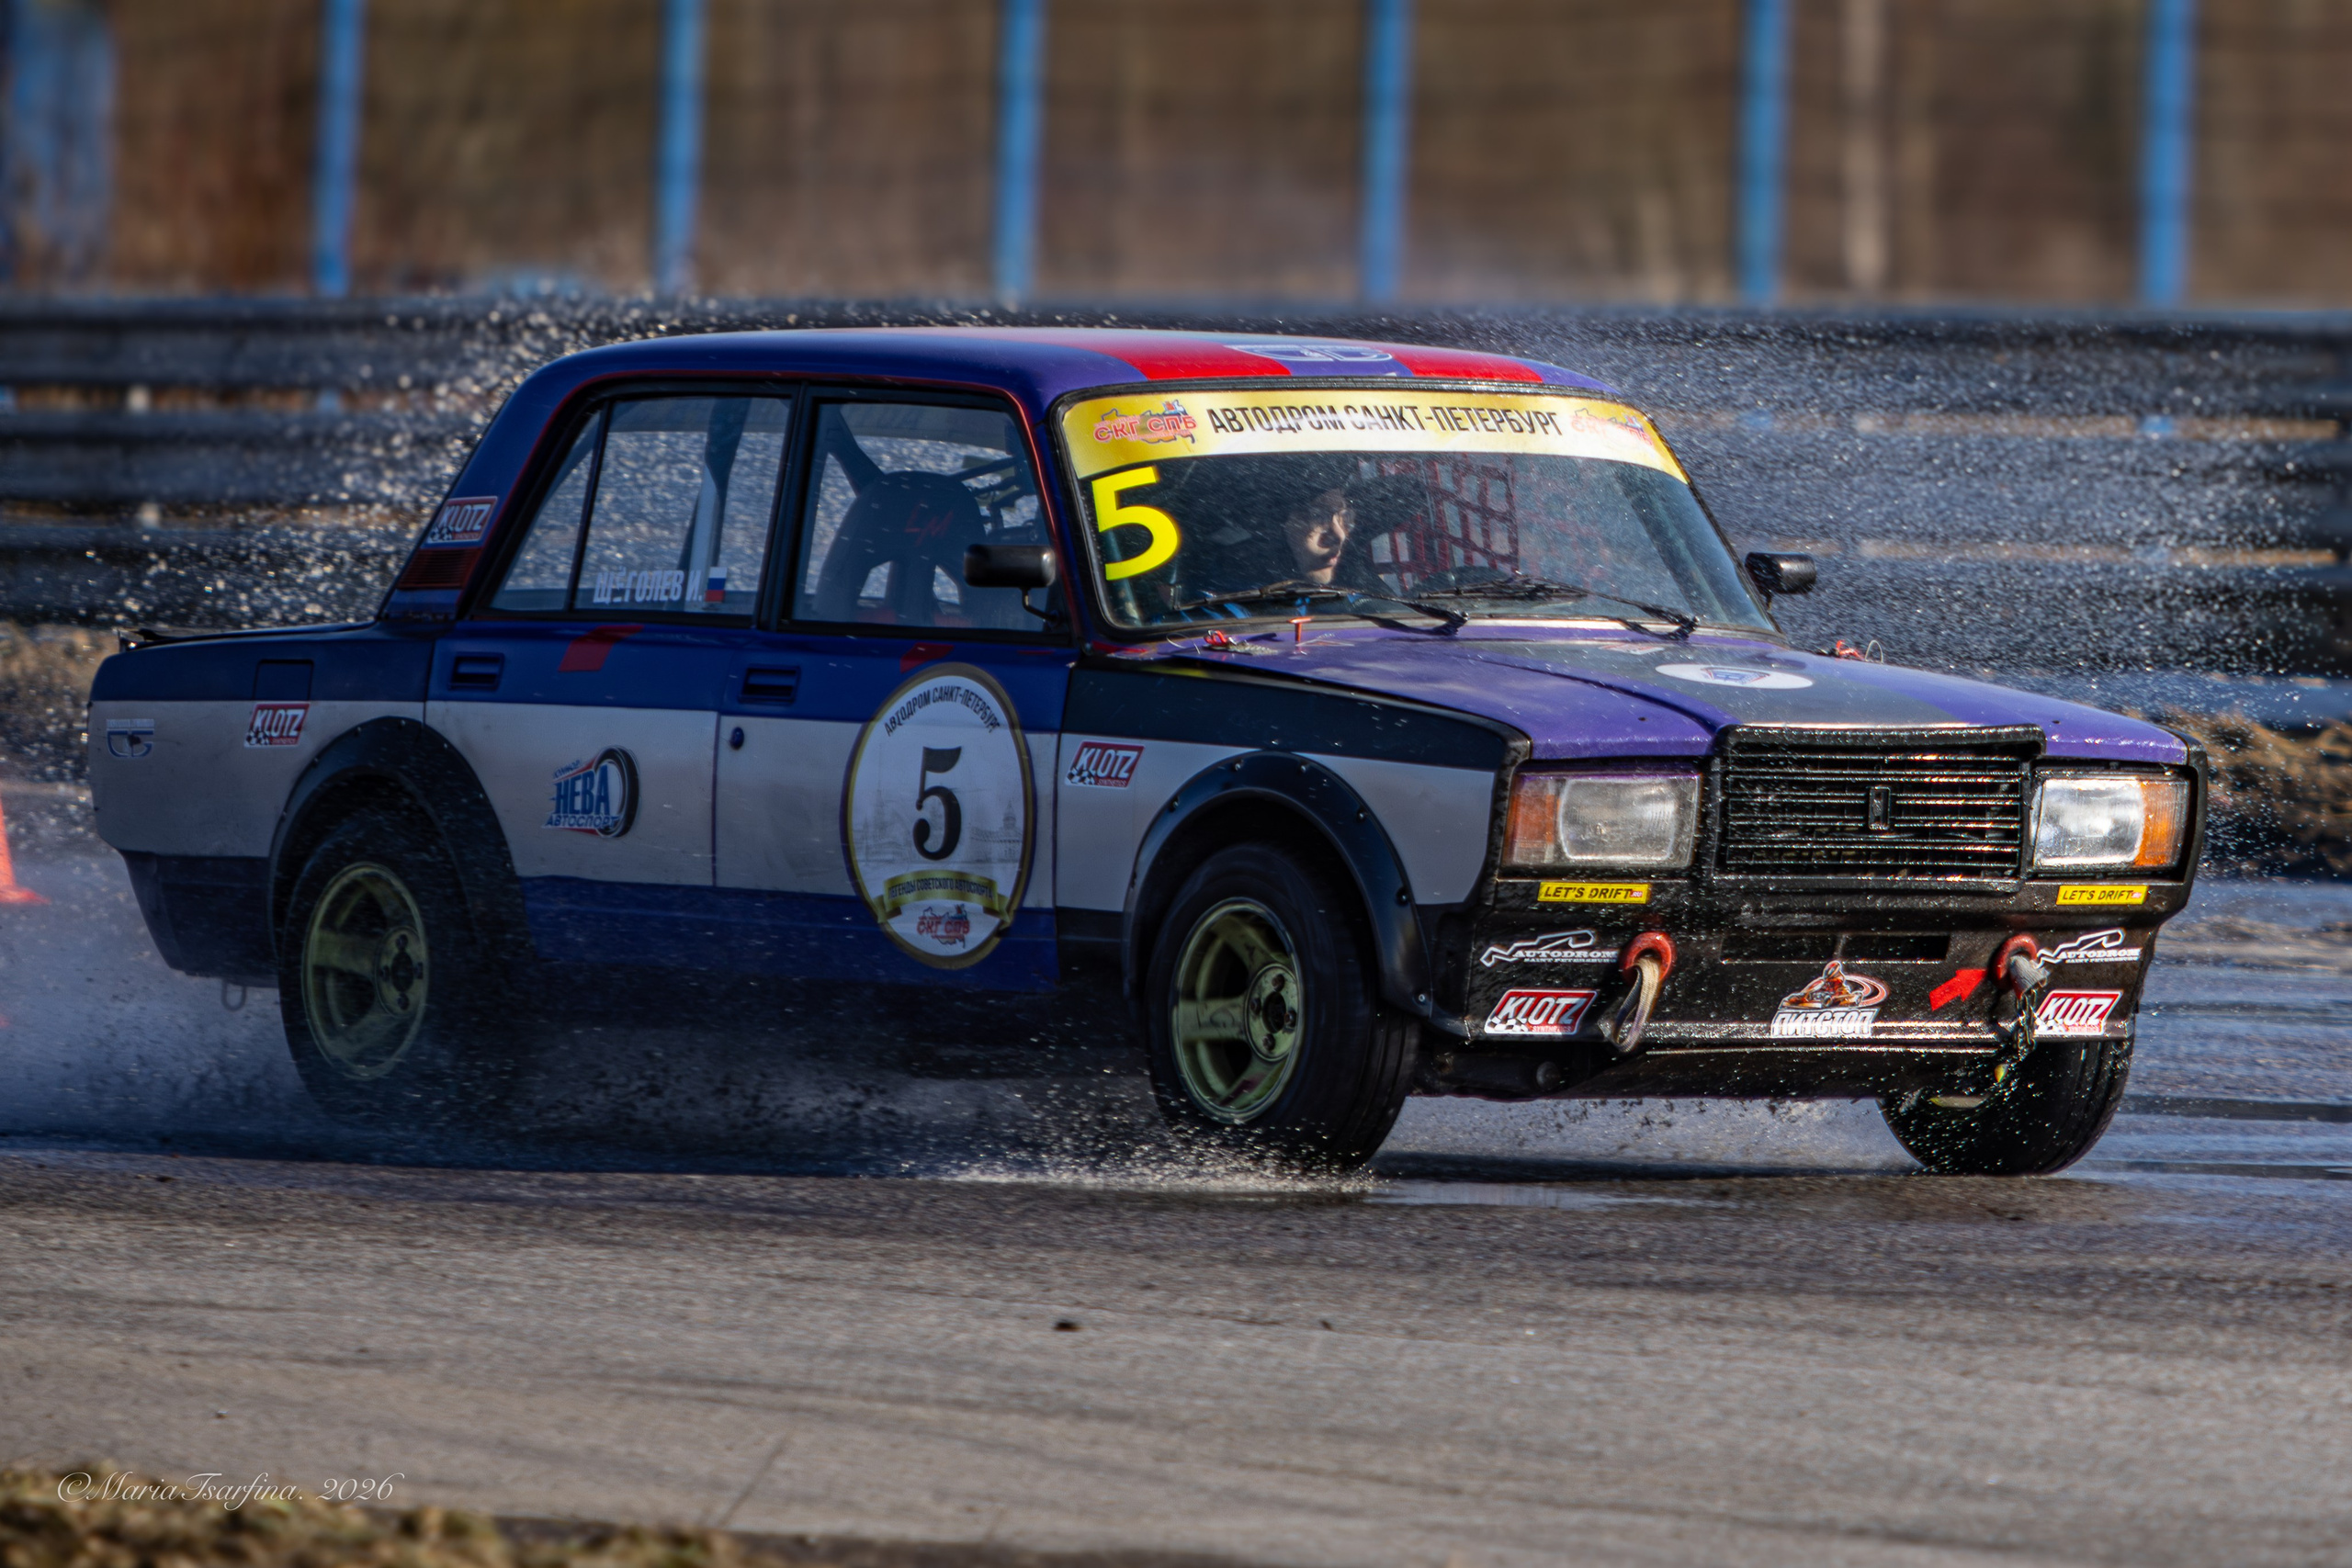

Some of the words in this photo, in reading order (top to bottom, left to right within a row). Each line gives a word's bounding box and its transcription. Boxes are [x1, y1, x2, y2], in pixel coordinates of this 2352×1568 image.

[1147, 415, 1198, 433] СПБ
[1205, 406, 1345, 434] АВТОДРОМ
[1344, 405, 1564, 436] САНКТ-ПЕТЕРБУРГ
[438, 503, 492, 533] KLOTZ
[1091, 466, 1181, 582] 5
[685, 570, 703, 603] И.
[253, 708, 305, 738] KLOTZ
[884, 689, 931, 737] АВТОДРОМ
[932, 685, 1000, 733] САНКТ-ПЕТЕРБУРГ
[1075, 747, 1138, 779] KLOTZ
[554, 764, 610, 816] НЕВА
[913, 746, 962, 860] 5
[545, 814, 620, 829] АВТОСПОРТ
[1544, 886, 1585, 898] LET'S
[2063, 890, 2096, 900] LET'S
[1512, 949, 1619, 958] AUTODROM
[2056, 947, 2142, 959] AUTODROM
[1498, 996, 1588, 1025] KLOTZ
[1773, 1010, 1875, 1037] ПИТСТОП
[2040, 997, 2114, 1026] KLOTZ
